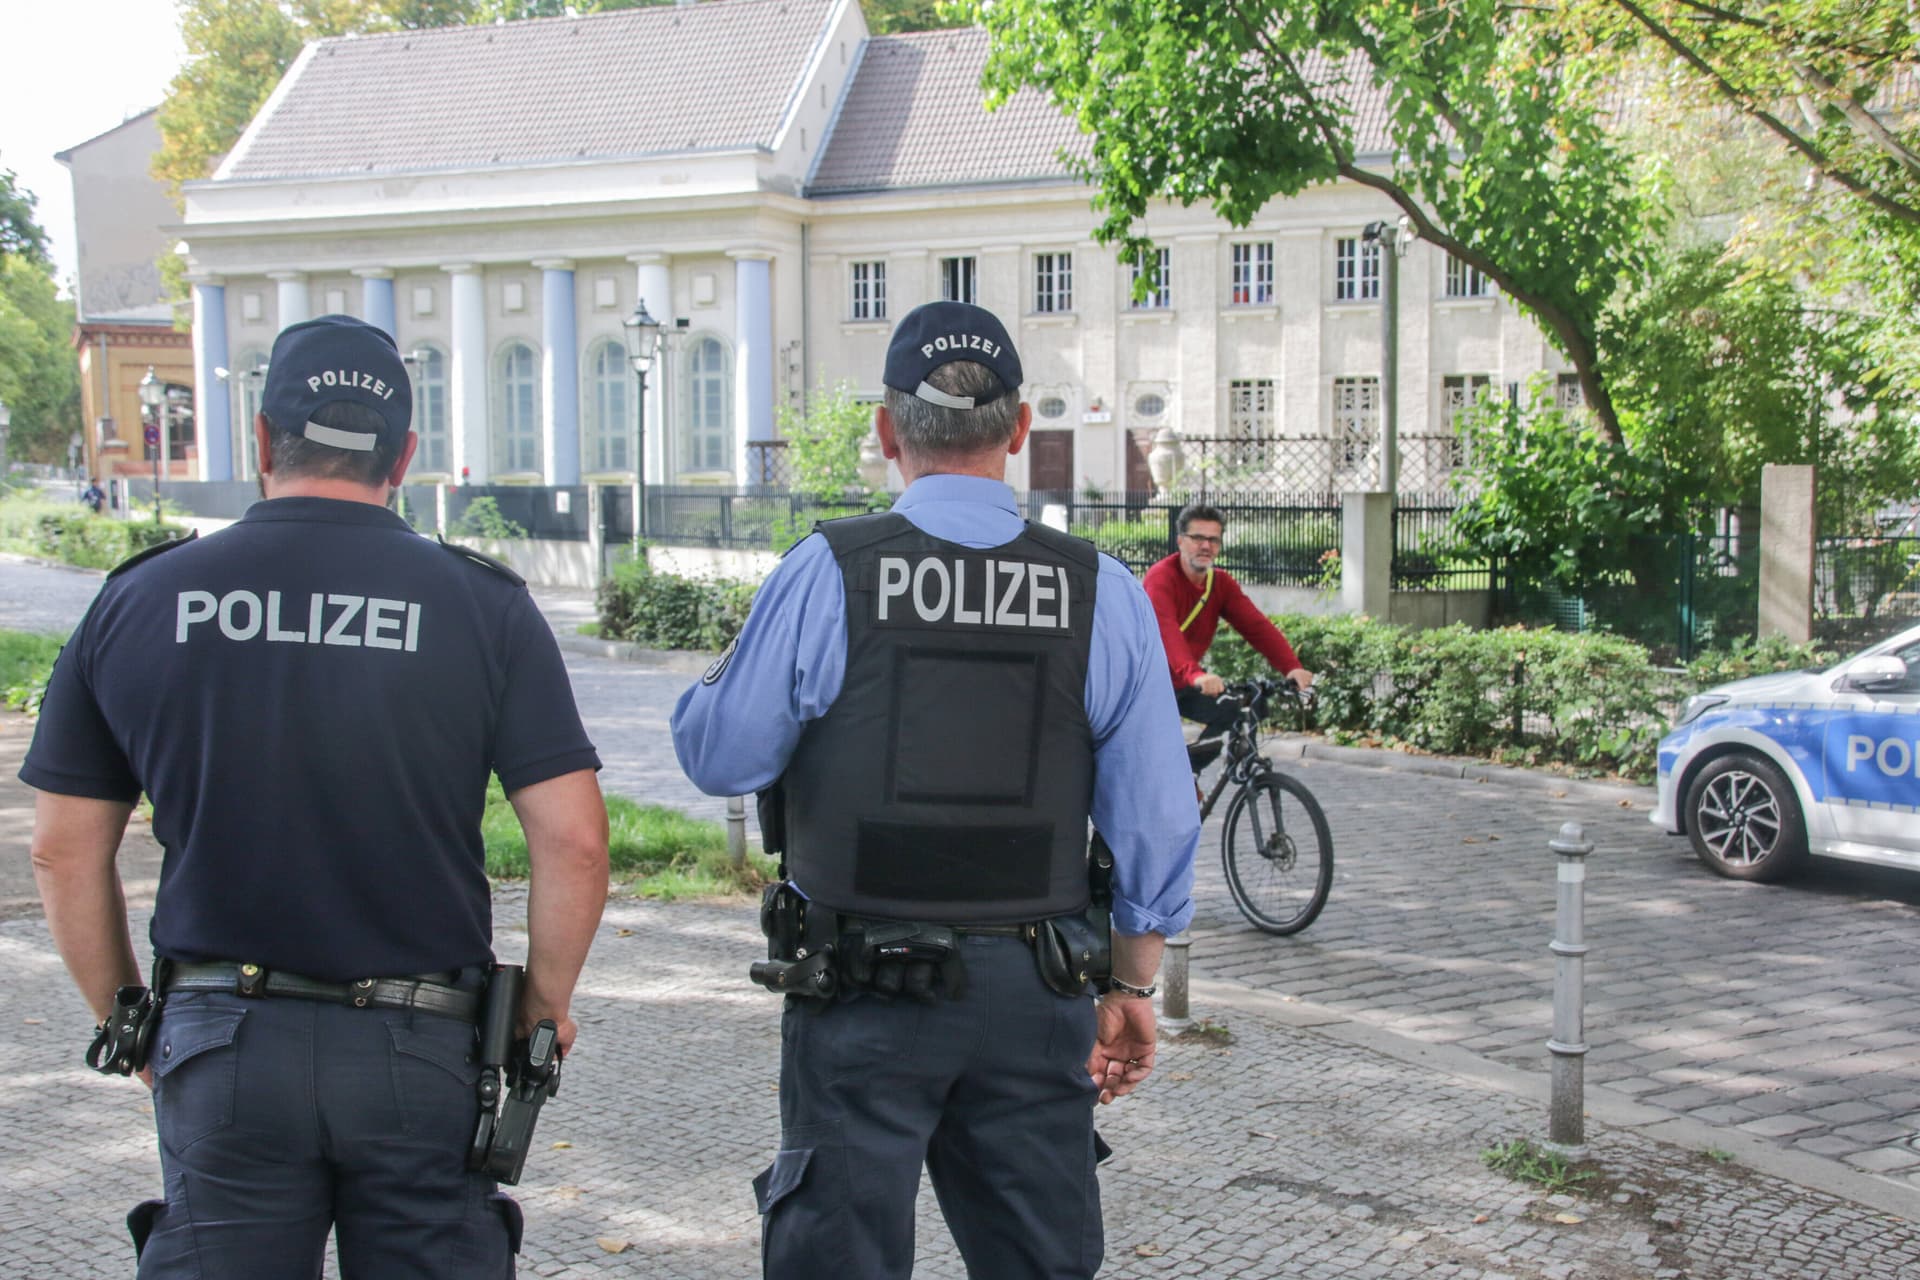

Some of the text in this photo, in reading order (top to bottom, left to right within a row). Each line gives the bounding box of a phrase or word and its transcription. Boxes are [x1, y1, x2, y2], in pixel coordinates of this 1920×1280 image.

[920, 334, 1001, 359] POLIZEI
[307, 370, 394, 400] POLIZEI
[878, 556, 1070, 629] POLIZEI
[176, 590, 422, 652] POLIZEI
[1847, 735, 1920, 778] PO
